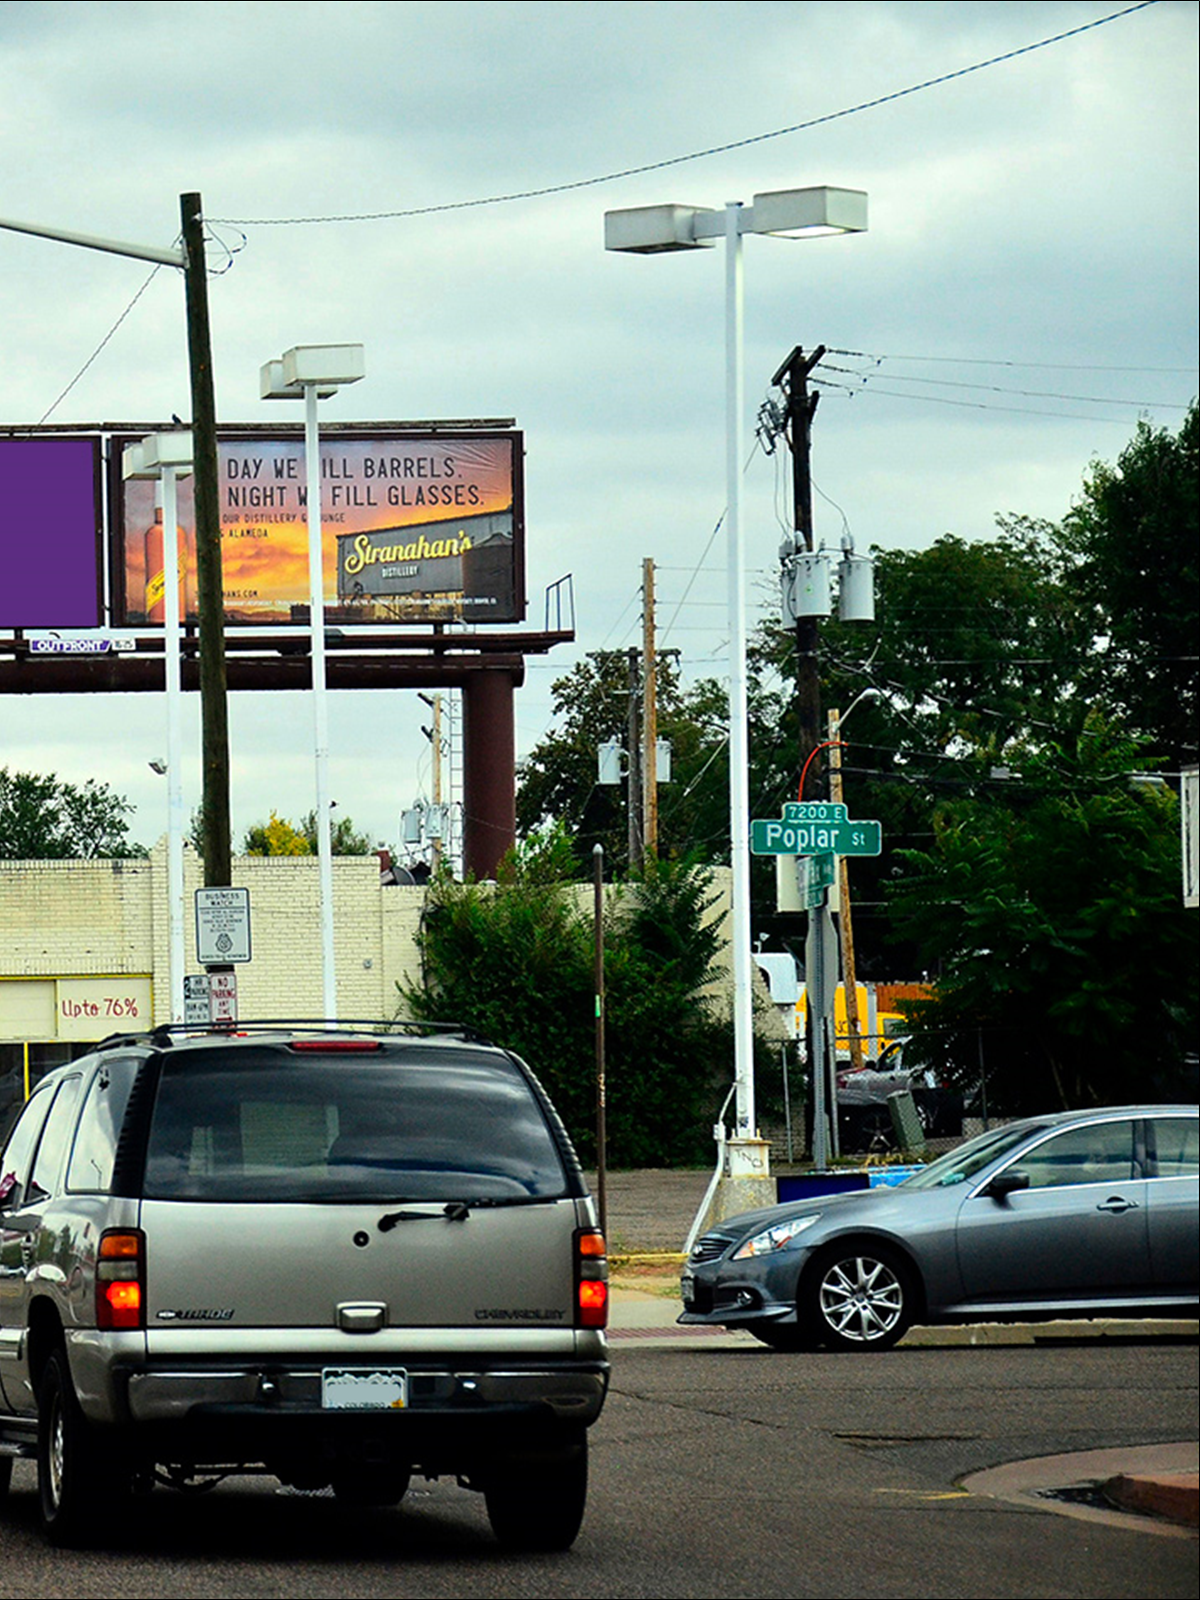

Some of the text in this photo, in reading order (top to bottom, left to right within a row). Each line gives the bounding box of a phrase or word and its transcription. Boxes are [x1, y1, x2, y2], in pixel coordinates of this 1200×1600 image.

[227, 457, 462, 479] DAY WE ILL BARRELS.
[228, 486, 287, 507] NIGHT
[332, 486, 377, 506] FILL
[388, 484, 484, 506] GLASSES.
[222, 513, 240, 523] OUR
[244, 513, 298, 523] DISTILLERY
[229, 528, 269, 538] ALAMEDA
[344, 529, 473, 574] Stranahan's
[382, 565, 418, 578] DISTILLERY
[37, 639, 102, 651] OUTFRONT
[788, 806, 842, 819] 7200 E
[766, 824, 865, 853] Poplar St
[205, 892, 240, 900] BUSINESS
[217, 977, 228, 988] NO
[212, 988, 235, 999] PARKING
[103, 998, 139, 1018] 76%
[179, 1309, 235, 1320] TAHOE
[474, 1309, 566, 1320] CHEVROLET
